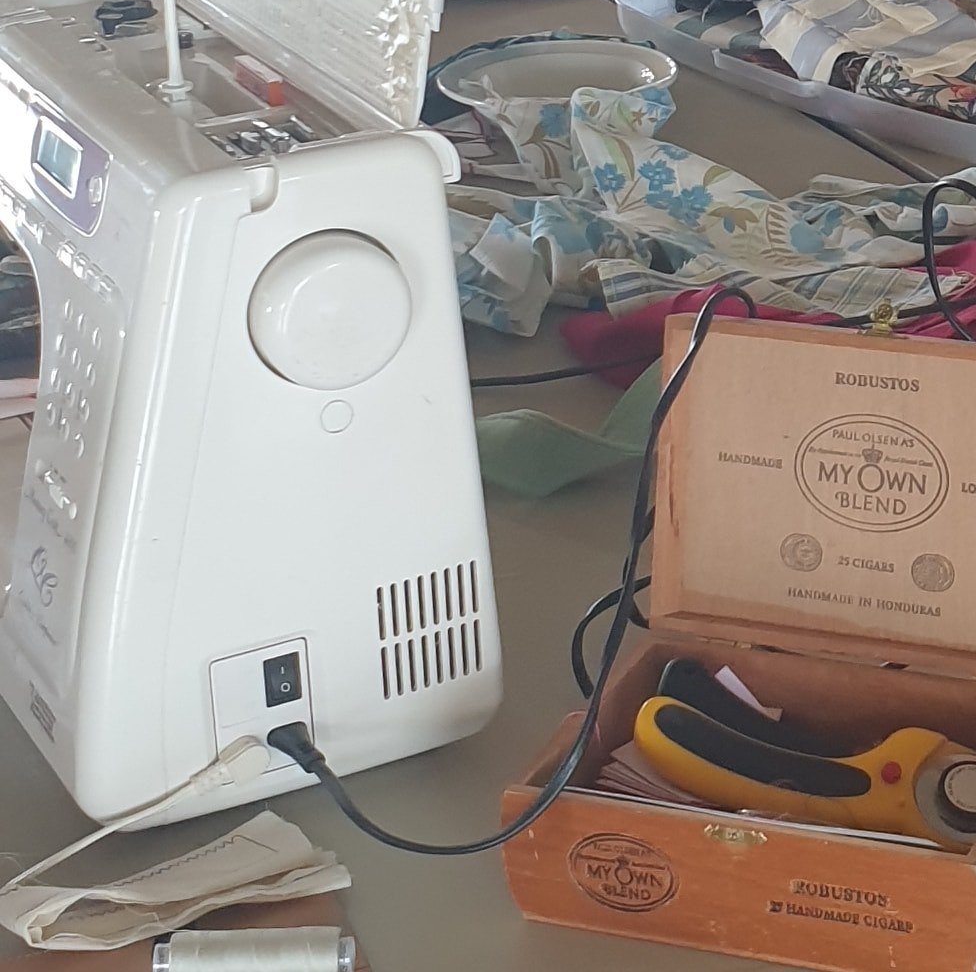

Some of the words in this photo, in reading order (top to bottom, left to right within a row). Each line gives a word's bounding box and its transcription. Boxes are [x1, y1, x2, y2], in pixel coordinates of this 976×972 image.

[835, 372, 920, 392] ROBUSTOS
[832, 429, 860, 442] PAUL
[862, 433, 898, 446] OLSEN
[718, 451, 783, 469] HANDMADE
[818, 461, 854, 484] MY
[858, 463, 927, 495] OWN
[835, 491, 907, 515] BLEND
[838, 555, 850, 566] 25
[852, 558, 895, 572] CIGARS
[787, 587, 853, 605] HANDMADE
[859, 597, 872, 608] IN
[876, 599, 941, 617] HONDURAS
[587, 863, 611, 880] MY
[615, 867, 662, 887] OWN
[601, 883, 651, 900] BLEND
[793, 880, 889, 907] ROBUSTOS
[786, 903, 860, 925] HANDMADE
